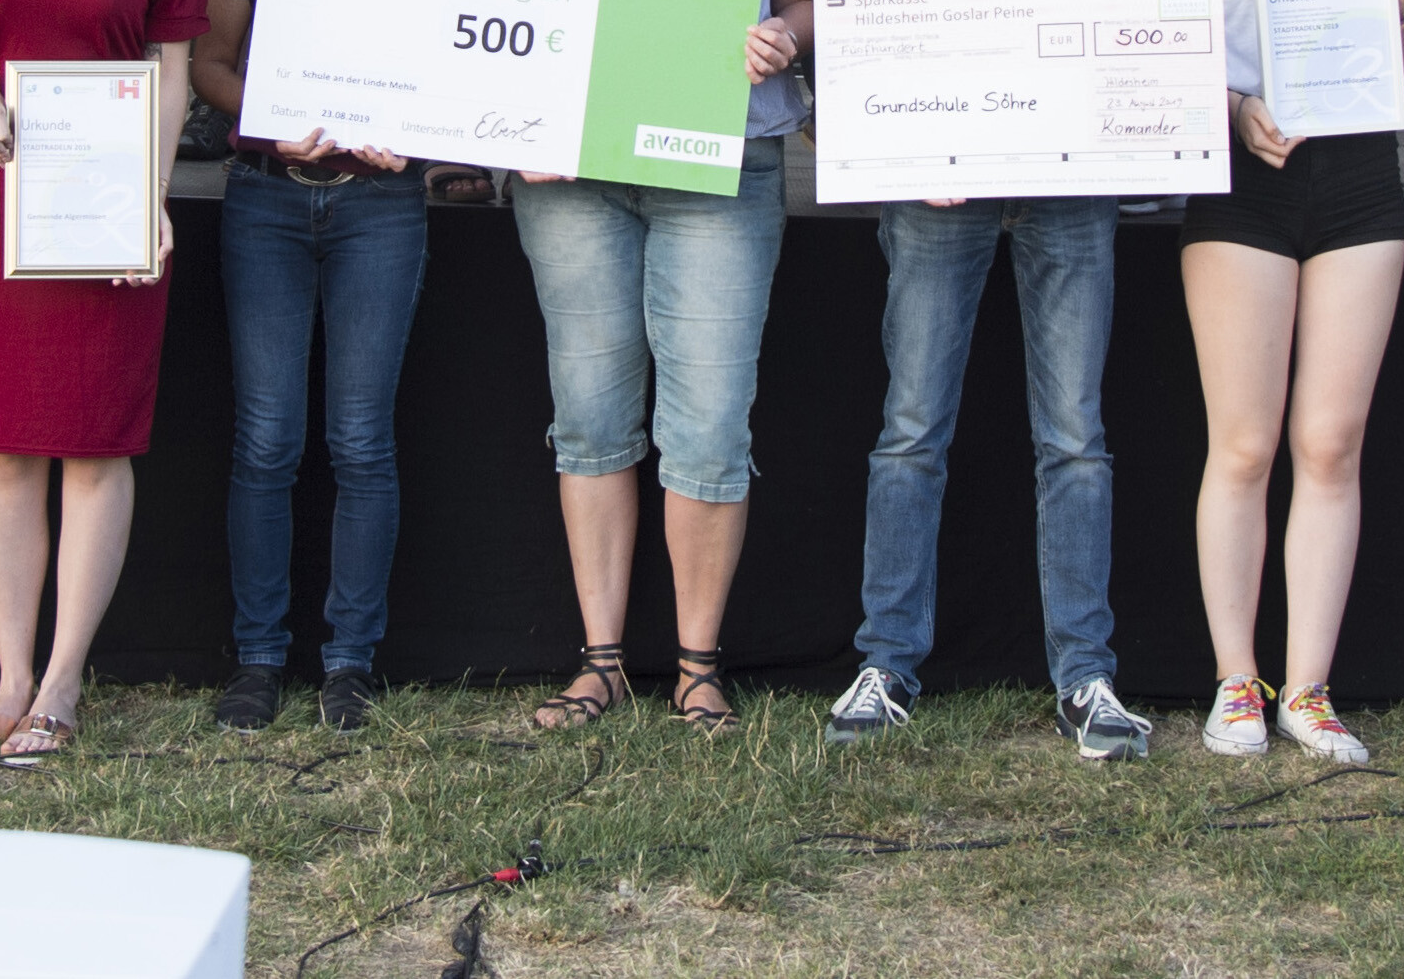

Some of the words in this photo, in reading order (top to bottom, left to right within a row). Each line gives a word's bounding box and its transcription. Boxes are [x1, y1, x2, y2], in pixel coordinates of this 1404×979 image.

[855, 11, 938, 26] Hildesheim
[943, 8, 989, 22] Goslar
[994, 6, 1034, 19] Peine
[453, 13, 535, 57] 500
[545, 29, 565, 53] €
[1273, 24, 1321, 34] STADTRADELN
[1049, 36, 1073, 45] EUR
[276, 67, 292, 80] für
[302, 69, 331, 82] Schule
[334, 74, 344, 82] an
[346, 75, 361, 85] der
[363, 77, 387, 88] Linde
[389, 80, 417, 91] Mehle
[270, 104, 307, 118] Datum
[321, 108, 370, 123] 23.08.2019
[864, 93, 969, 115] Grundschule
[22, 119, 71, 131] Urkunde
[401, 120, 465, 139] Unterschrift
[1101, 114, 1181, 135] Komander
[642, 132, 721, 158] avacon
